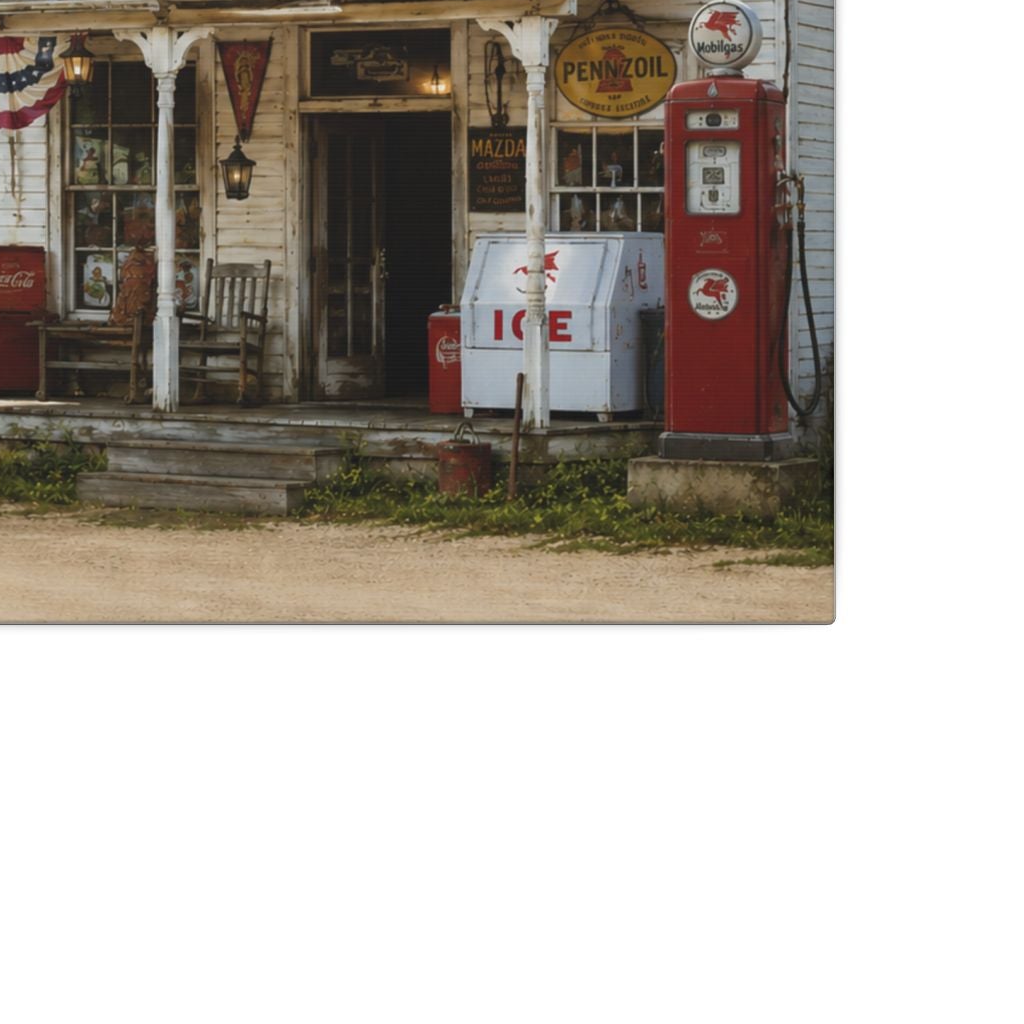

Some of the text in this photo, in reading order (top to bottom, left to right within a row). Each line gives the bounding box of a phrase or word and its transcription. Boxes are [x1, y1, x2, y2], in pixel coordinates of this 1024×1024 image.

[697, 40, 743, 55] Mobilgas
[563, 56, 668, 84] PENNZOIL
[472, 138, 526, 158] MAZDA
